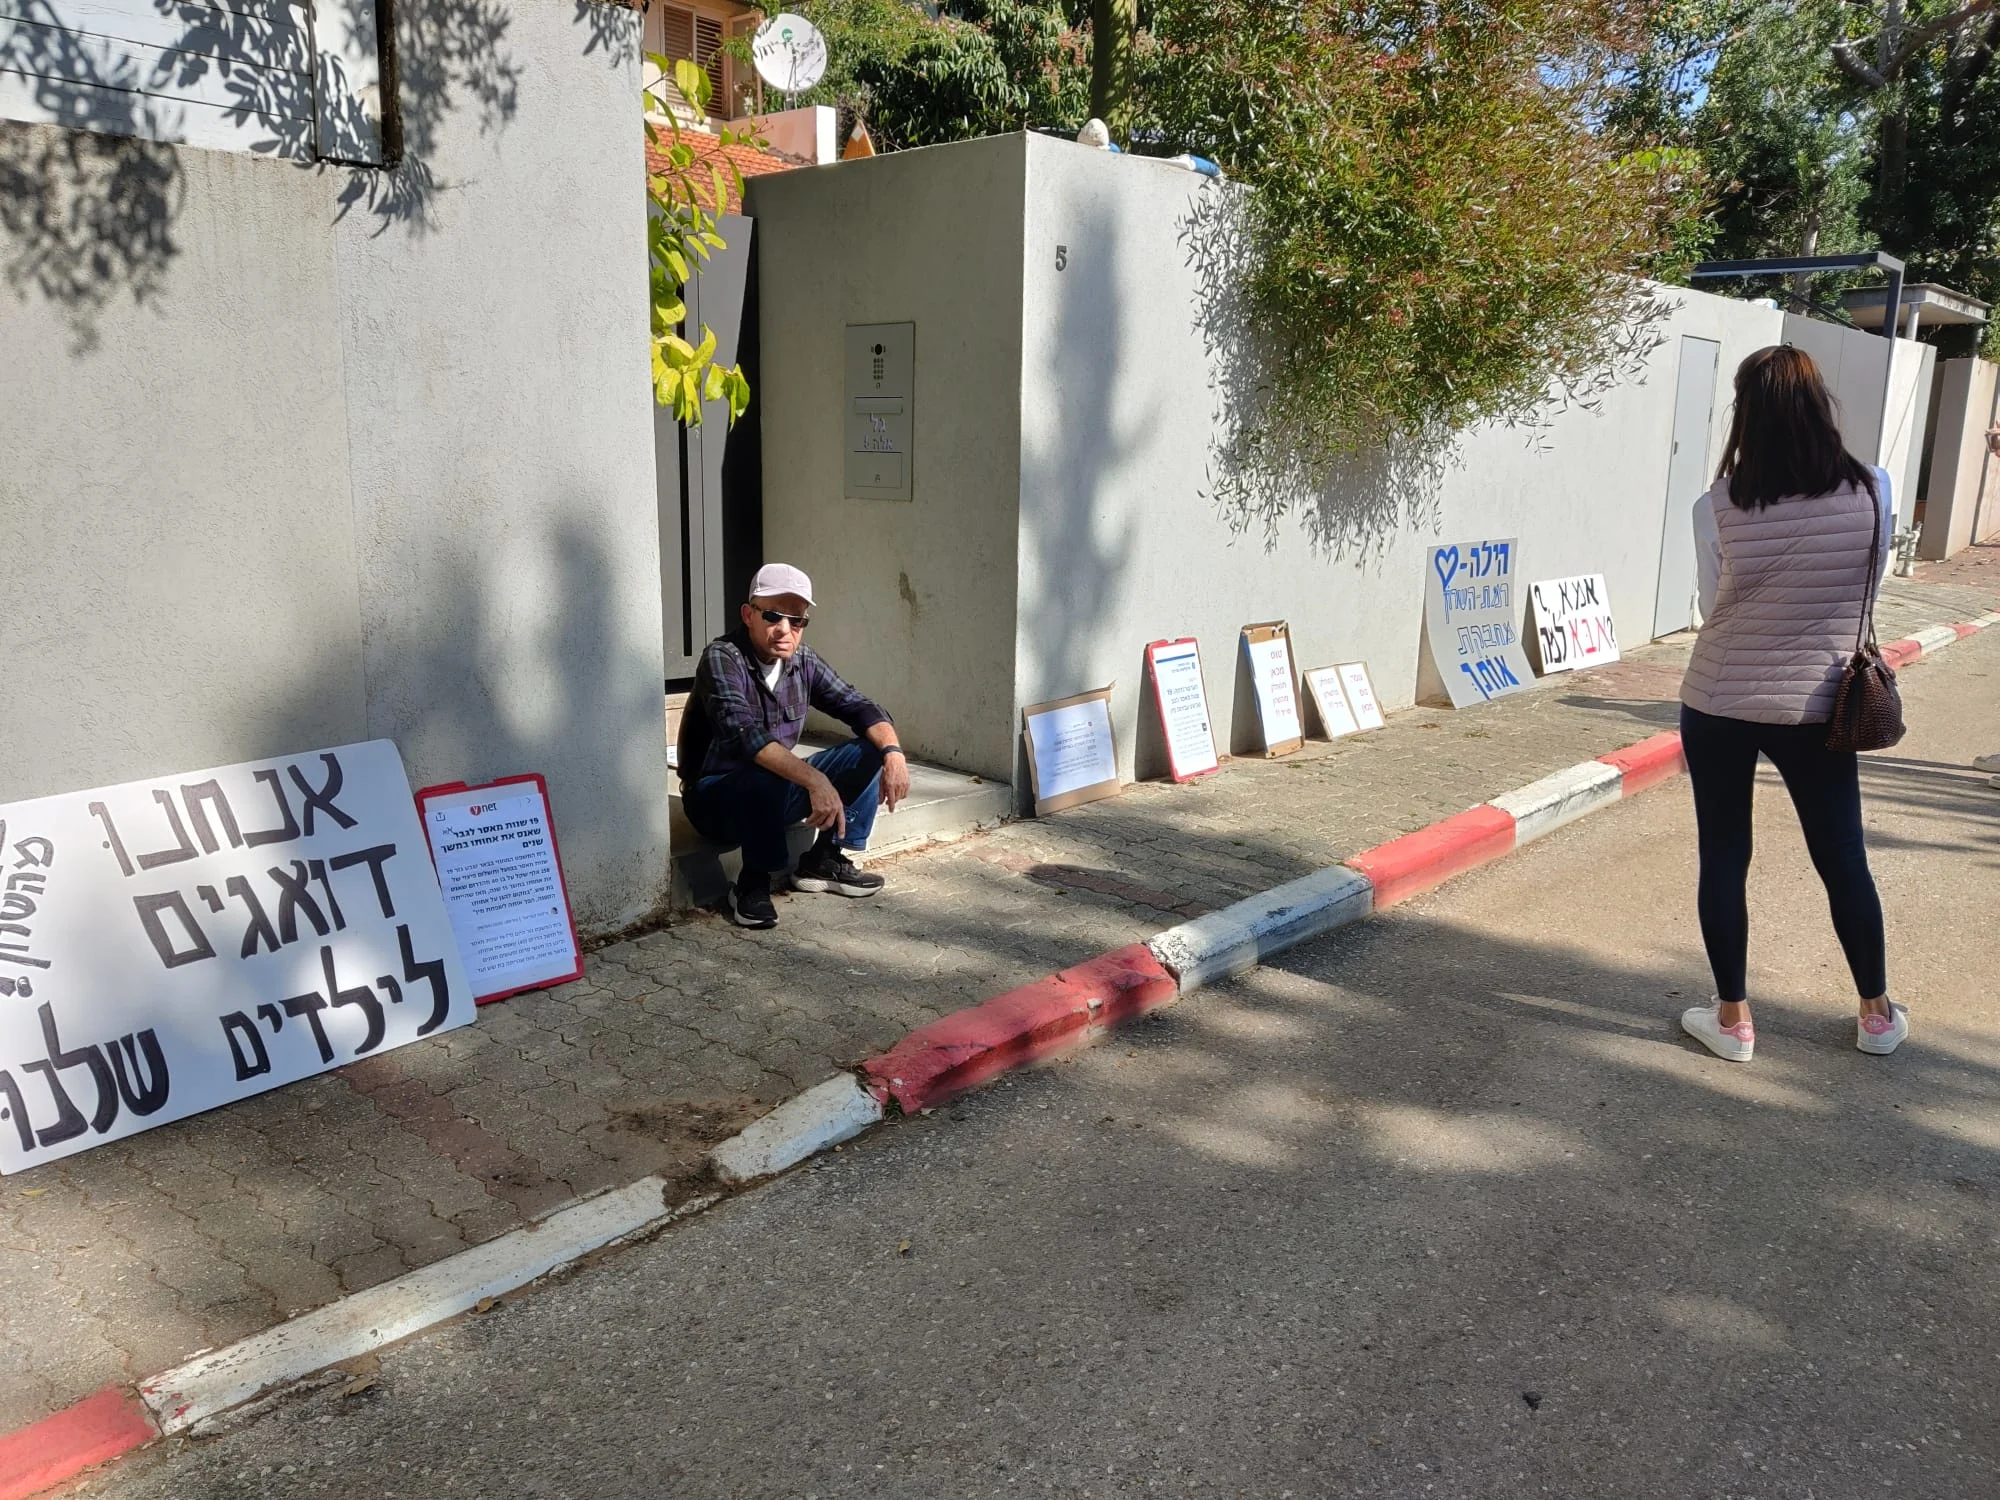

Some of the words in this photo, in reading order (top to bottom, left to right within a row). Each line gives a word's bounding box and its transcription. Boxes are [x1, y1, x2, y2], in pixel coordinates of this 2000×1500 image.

[1055, 245, 1067, 271] 5
[1457, 621, 1515, 658] מחבקת
[1460, 655, 1520, 700] אותך
[89, 752, 358, 877] אנחנו
[470, 802, 498, 816] ynet
[478, 824, 503, 833] מאסר
[506, 819, 527, 829] שנות
[453, 828, 475, 838] לגבר
[517, 828, 541, 838] שאנס
[441, 841, 469, 853] במשך
[471, 836, 499, 846] אחותו
[522, 838, 544, 848] שנים
[132, 843, 397, 969] דואגים
[219, 924, 450, 1082] לילדים
[0, 1000, 170, 1152] שלנו
